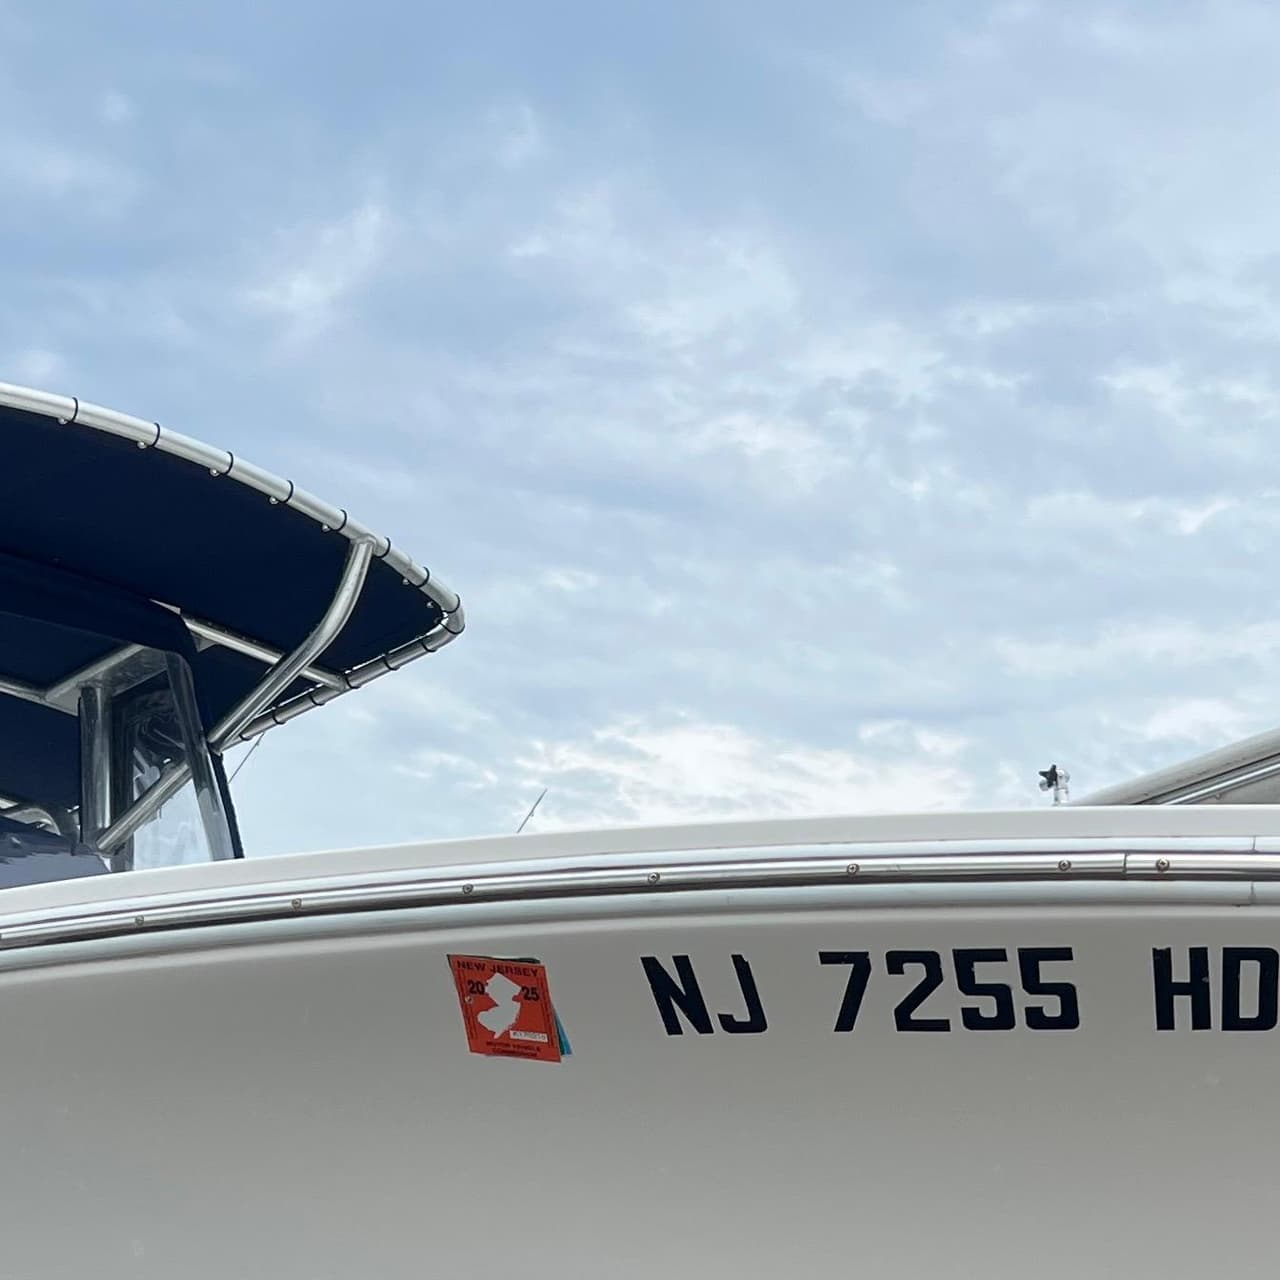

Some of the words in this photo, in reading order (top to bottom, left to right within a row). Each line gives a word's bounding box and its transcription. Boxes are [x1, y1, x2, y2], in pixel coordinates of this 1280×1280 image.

[456, 960, 486, 972] NEW
[490, 964, 538, 977] JERSEY
[467, 979, 486, 996] 20
[521, 986, 540, 1001] 25
[640, 954, 767, 1035] NJ
[818, 947, 1079, 1032] 7255
[1152, 947, 1279, 1031] HD
